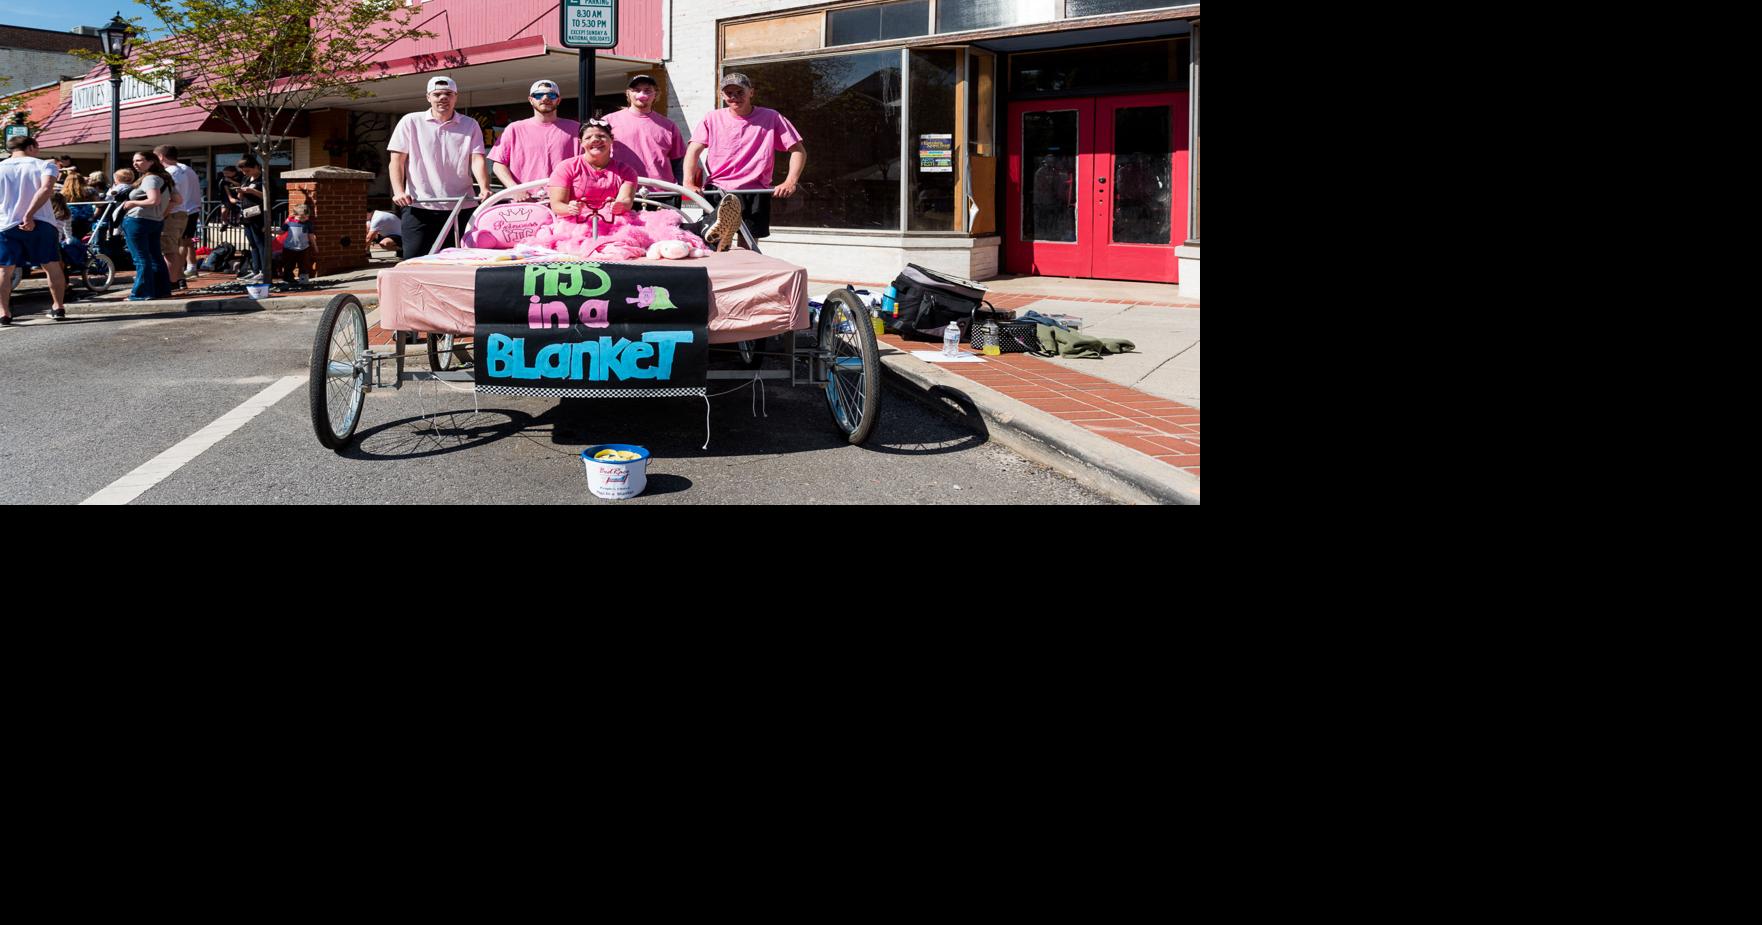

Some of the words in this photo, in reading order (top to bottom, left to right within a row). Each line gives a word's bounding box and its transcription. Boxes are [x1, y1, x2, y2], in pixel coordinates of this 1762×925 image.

[572, 19, 580, 27] TO
[597, 20, 606, 28] PM
[73, 83, 105, 111] ANTIQUES
[528, 294, 570, 329] in
[578, 299, 610, 329] a
